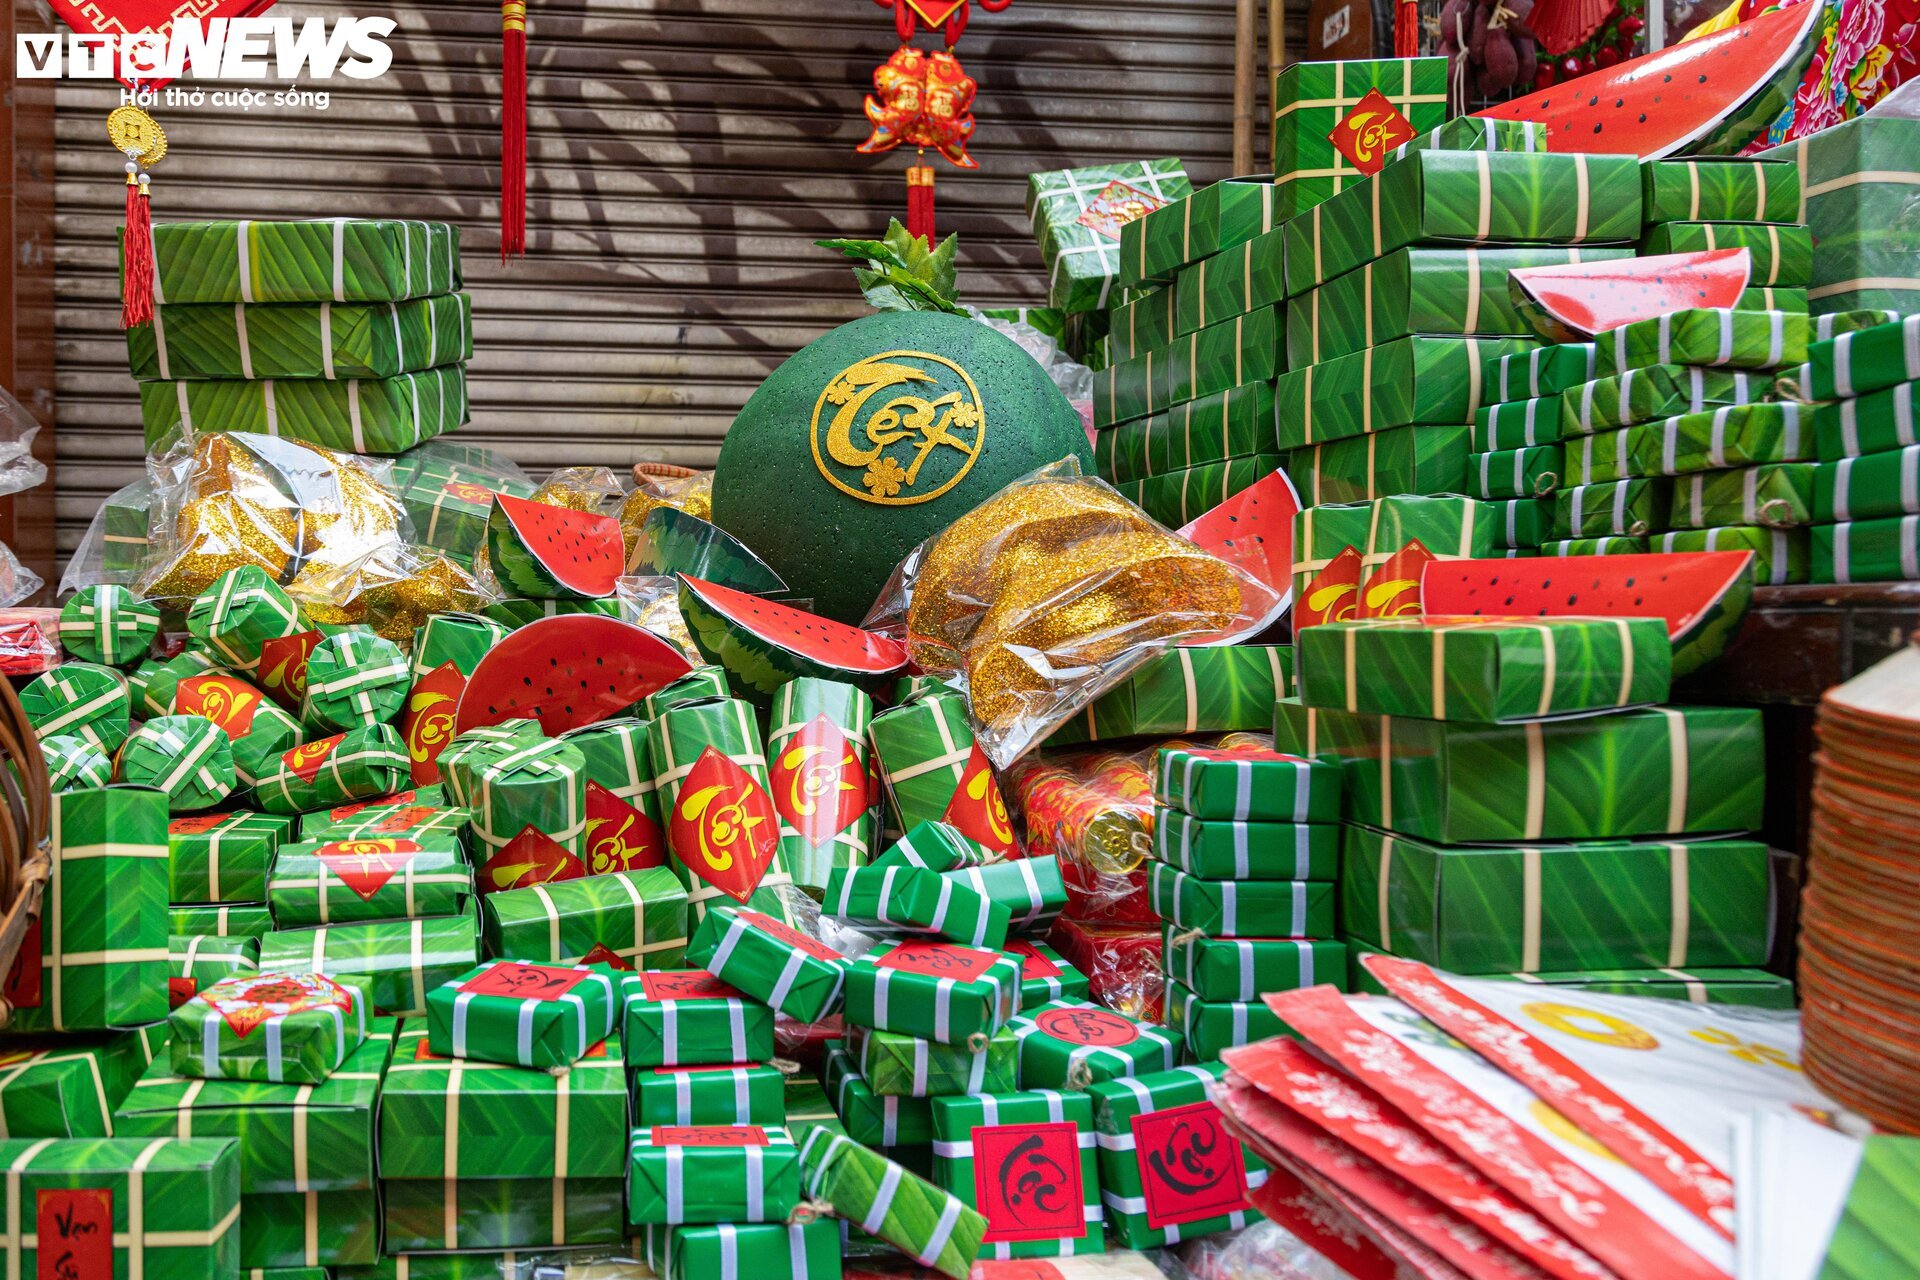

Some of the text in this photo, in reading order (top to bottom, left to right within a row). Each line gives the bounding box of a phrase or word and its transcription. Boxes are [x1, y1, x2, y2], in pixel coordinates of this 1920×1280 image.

[826, 362, 974, 486] Tết
[783, 744, 858, 816] Tết
[681, 782, 767, 872] Tết
